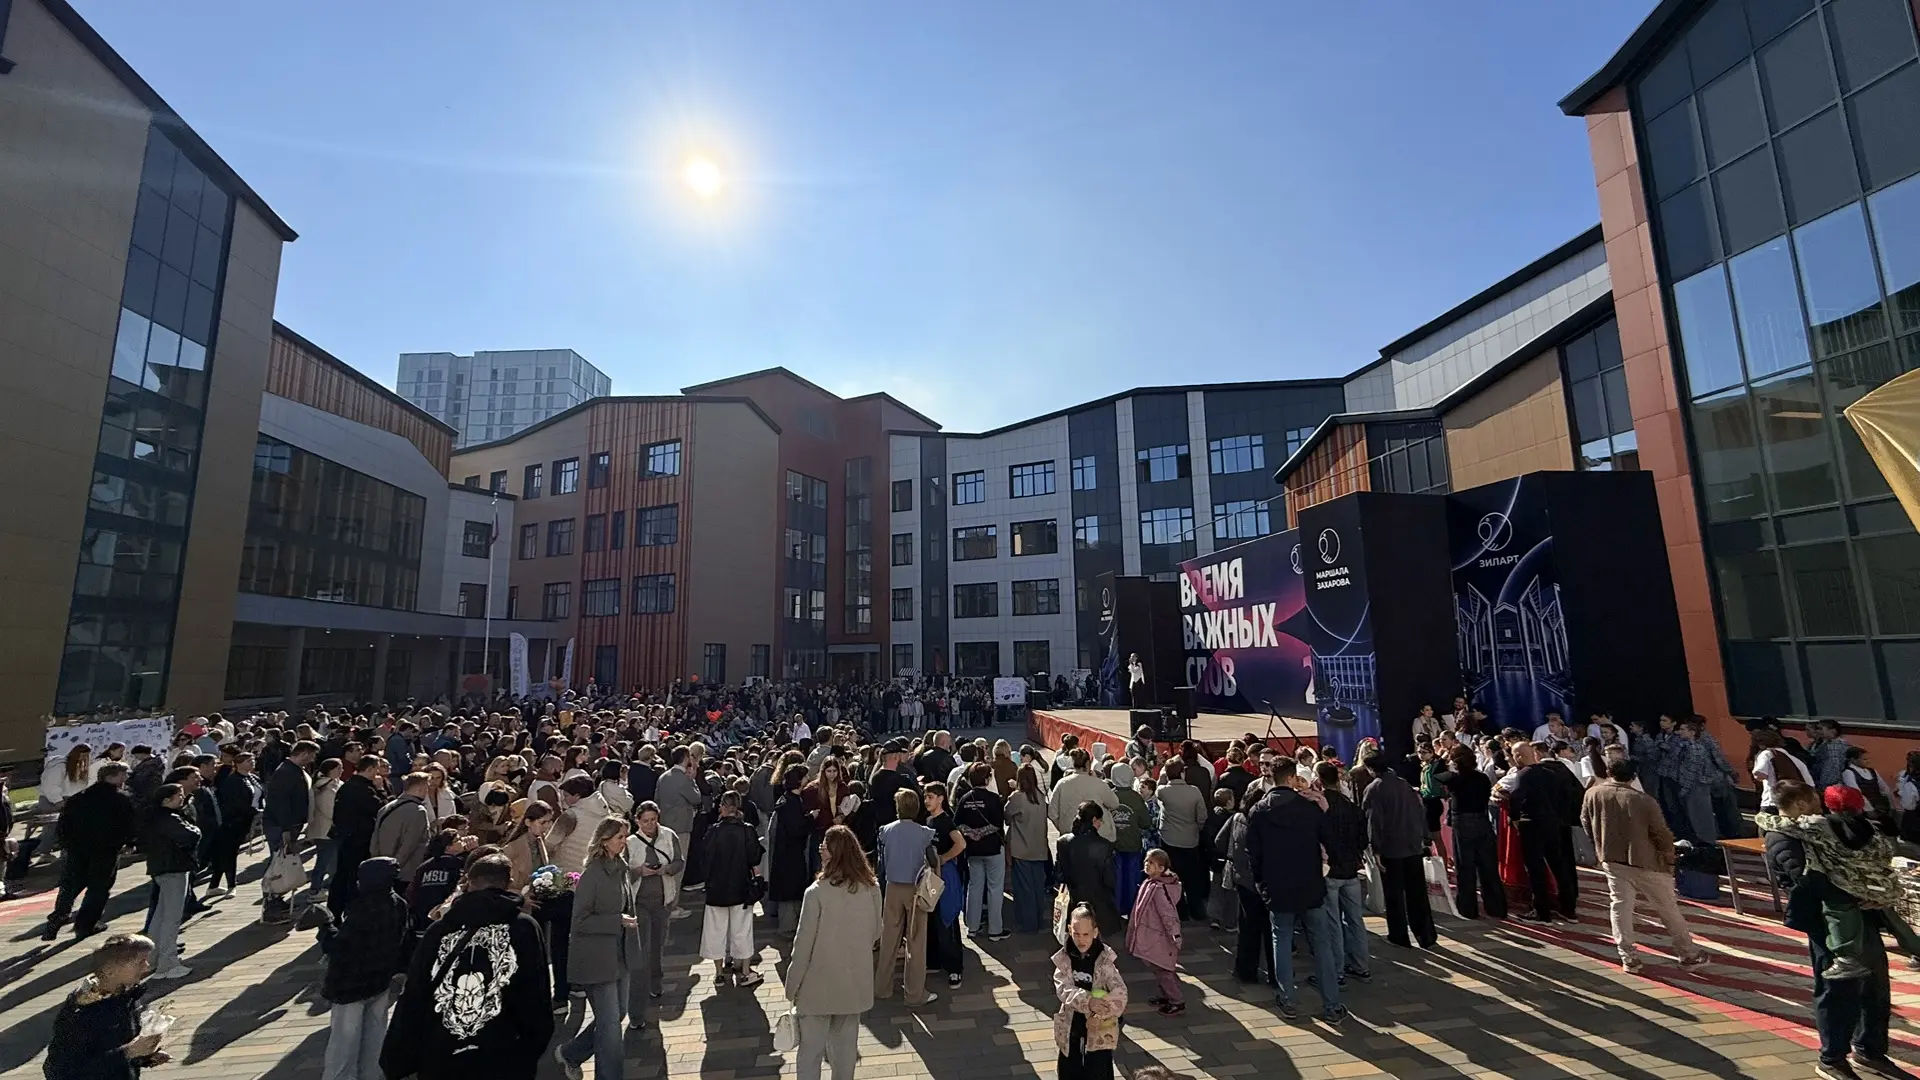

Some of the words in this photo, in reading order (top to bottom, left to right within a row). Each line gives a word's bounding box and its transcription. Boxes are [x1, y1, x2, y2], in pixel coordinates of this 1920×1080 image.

[1479, 554, 1520, 568] ЗИЛАРТ
[1315, 566, 1350, 580] МАРШАЛА
[1180, 557, 1244, 608] ВРЕМЯ
[1316, 577, 1351, 590] ЗАХАРОВА
[1182, 602, 1279, 650] ВАЖНЫХ
[1185, 656, 1238, 697] СЛОВ
[422, 870, 450, 882] MSU
